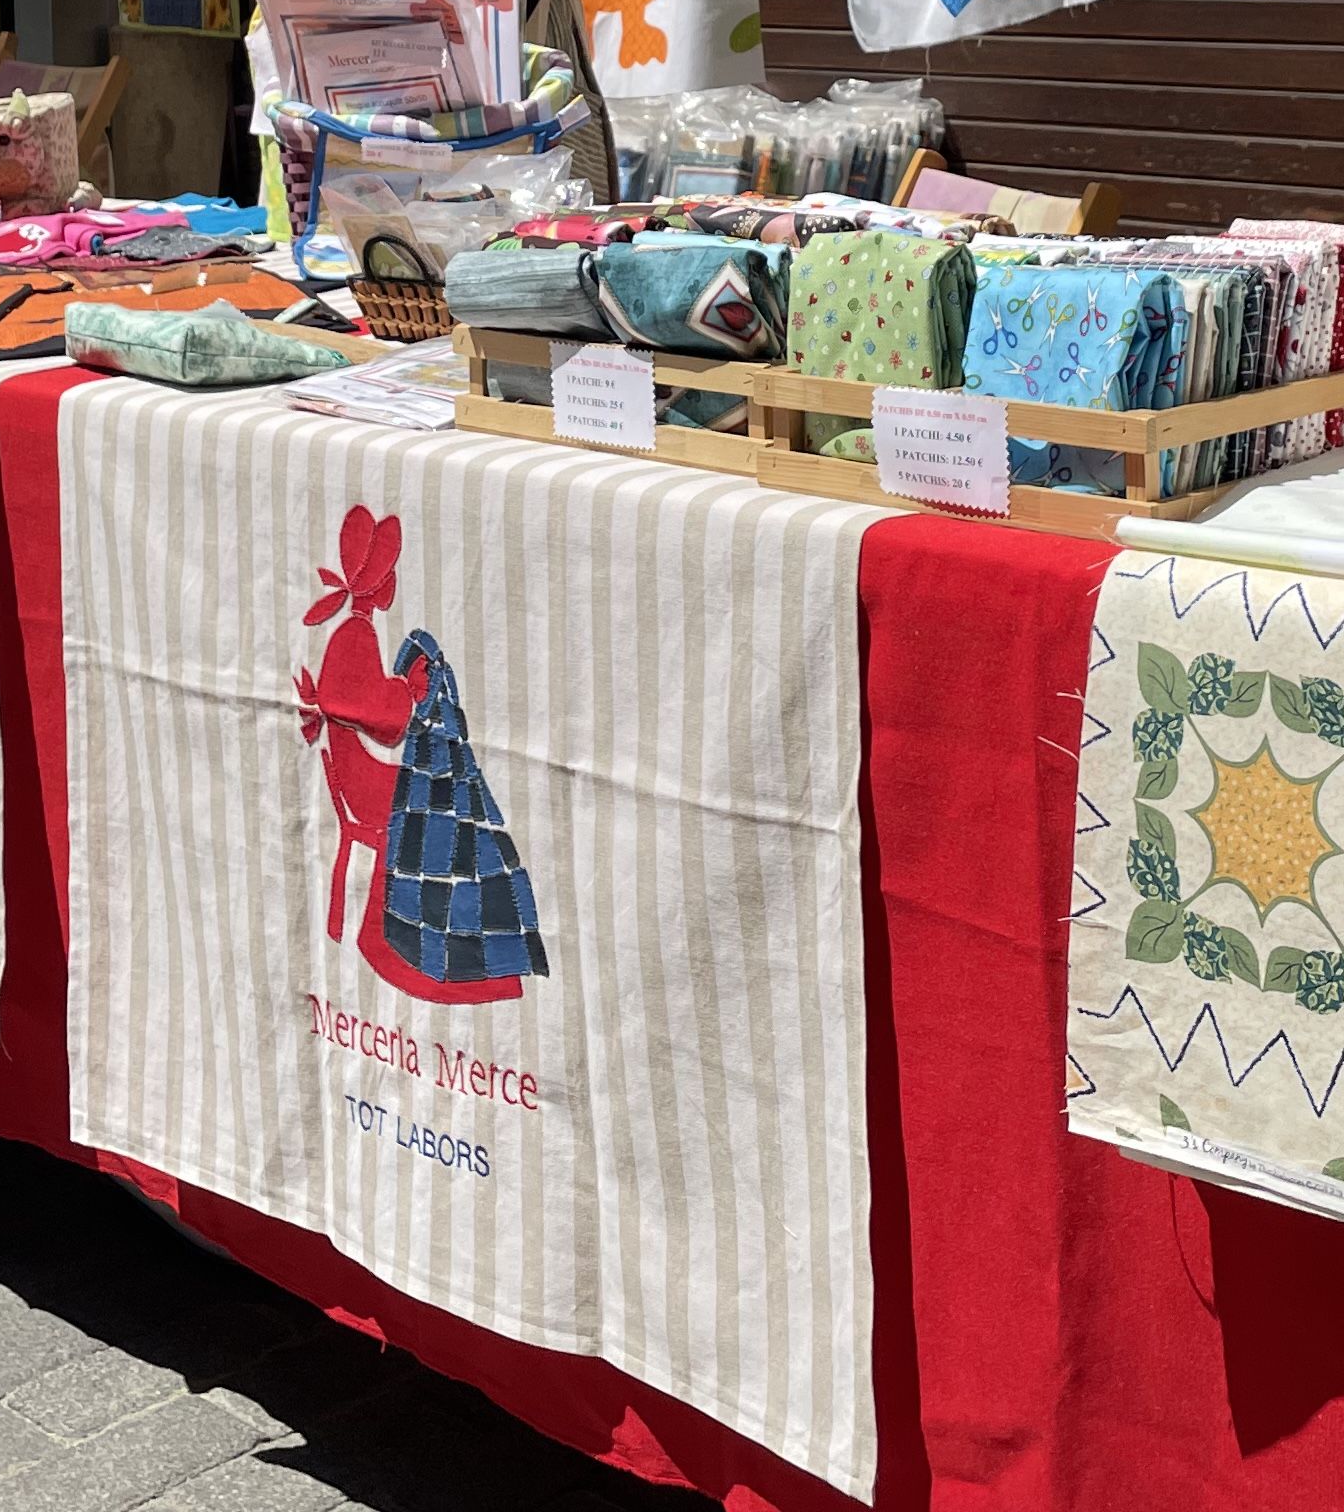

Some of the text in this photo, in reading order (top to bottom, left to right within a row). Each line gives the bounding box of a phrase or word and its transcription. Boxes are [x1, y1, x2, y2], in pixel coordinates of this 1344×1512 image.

[328, 55, 370, 68] Mercer
[877, 405, 913, 416] PATCHIS
[915, 409, 925, 417] DE
[901, 428, 944, 441] PATCHI:
[945, 433, 965, 443] 4.50
[966, 433, 973, 443] €
[902, 450, 950, 465] PATCHIS:
[952, 455, 976, 467] 12.50
[977, 457, 984, 467] €
[905, 472, 950, 487] PATCHIS:
[952, 478, 963, 488] 20
[964, 479, 972, 489] €
[434, 1042, 539, 1111] Merce
[345, 1094, 491, 1178] TOT LABORS
